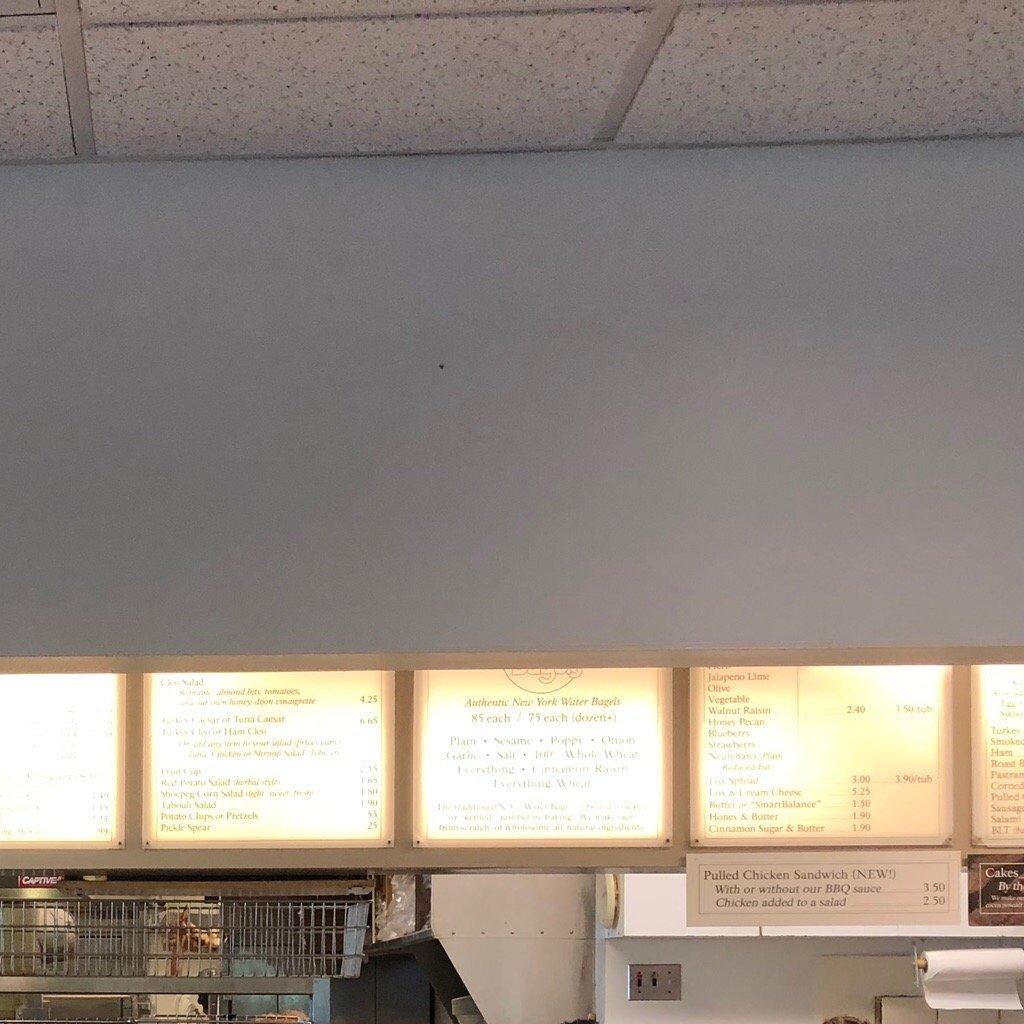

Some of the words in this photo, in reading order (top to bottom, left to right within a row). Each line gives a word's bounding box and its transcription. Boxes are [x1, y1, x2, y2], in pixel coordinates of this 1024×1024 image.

[707, 673, 746, 683] Jalapeno
[747, 672, 770, 681] Lime
[264, 688, 301, 696] tomatoes,
[707, 684, 731, 693] Olive
[359, 695, 378, 704] 4.25
[465, 698, 509, 707] Authentic
[512, 698, 534, 707] New
[537, 698, 558, 707] York
[561, 697, 589, 707] Water
[591, 697, 621, 708] Bagels
[708, 695, 751, 705] Vegetable
[708, 707, 741, 715] Walnut
[743, 706, 772, 715] Raisin
[846, 705, 866, 714] 2.40
[234, 715, 255, 724] Tuna
[256, 715, 285, 724] Caesar
[486, 713, 511, 723] each
[543, 713, 568, 723] each
[739, 718, 765, 726] Pecan
[450, 737, 477, 746] Plain
[494, 737, 533, 745] Sesame
[991, 749, 1013, 757] Ham
[208, 779, 231, 787] Salad
[851, 776, 871, 784] 3.00
[895, 774, 933, 784] 3.90/tub
[221, 790, 244, 798] Salad
[771, 788, 802, 797] Cheese
[851, 787, 871, 796] 5.25
[194, 801, 217, 809] Salad
[709, 801, 738, 809] Butter
[160, 813, 187, 821] Potato
[188, 812, 214, 822] Chips
[226, 812, 259, 821] Pretzels
[751, 813, 779, 821] Butter
[160, 824, 186, 832] Pickle
[187, 824, 212, 834] Spear
[708, 825, 756, 833] Cinnamon
[758, 825, 784, 835] Sugar
[786, 825, 794, 833] &
[797, 824, 826, 833] Butter
[704, 870, 739, 881] Pulled
[742, 870, 790, 880] Chicken
[794, 869, 849, 880] Sandwich
[852, 869, 897, 881] (NEW!)
[985, 868, 1019, 878] Cakes
[715, 885, 740, 895] With
[743, 886, 756, 894] or
[759, 884, 800, 894] without
[802, 886, 823, 894] our
[825, 884, 852, 895] BBQ
[852, 886, 882, 894] sauce
[923, 883, 946, 893] 3.50
[998, 882, 1011, 894] By
[716, 898, 759, 908] Chicken
[761, 898, 794, 907] added
[797, 899, 808, 907] to
[819, 897, 847, 907] salad
[923, 896, 946, 906] 2.50
